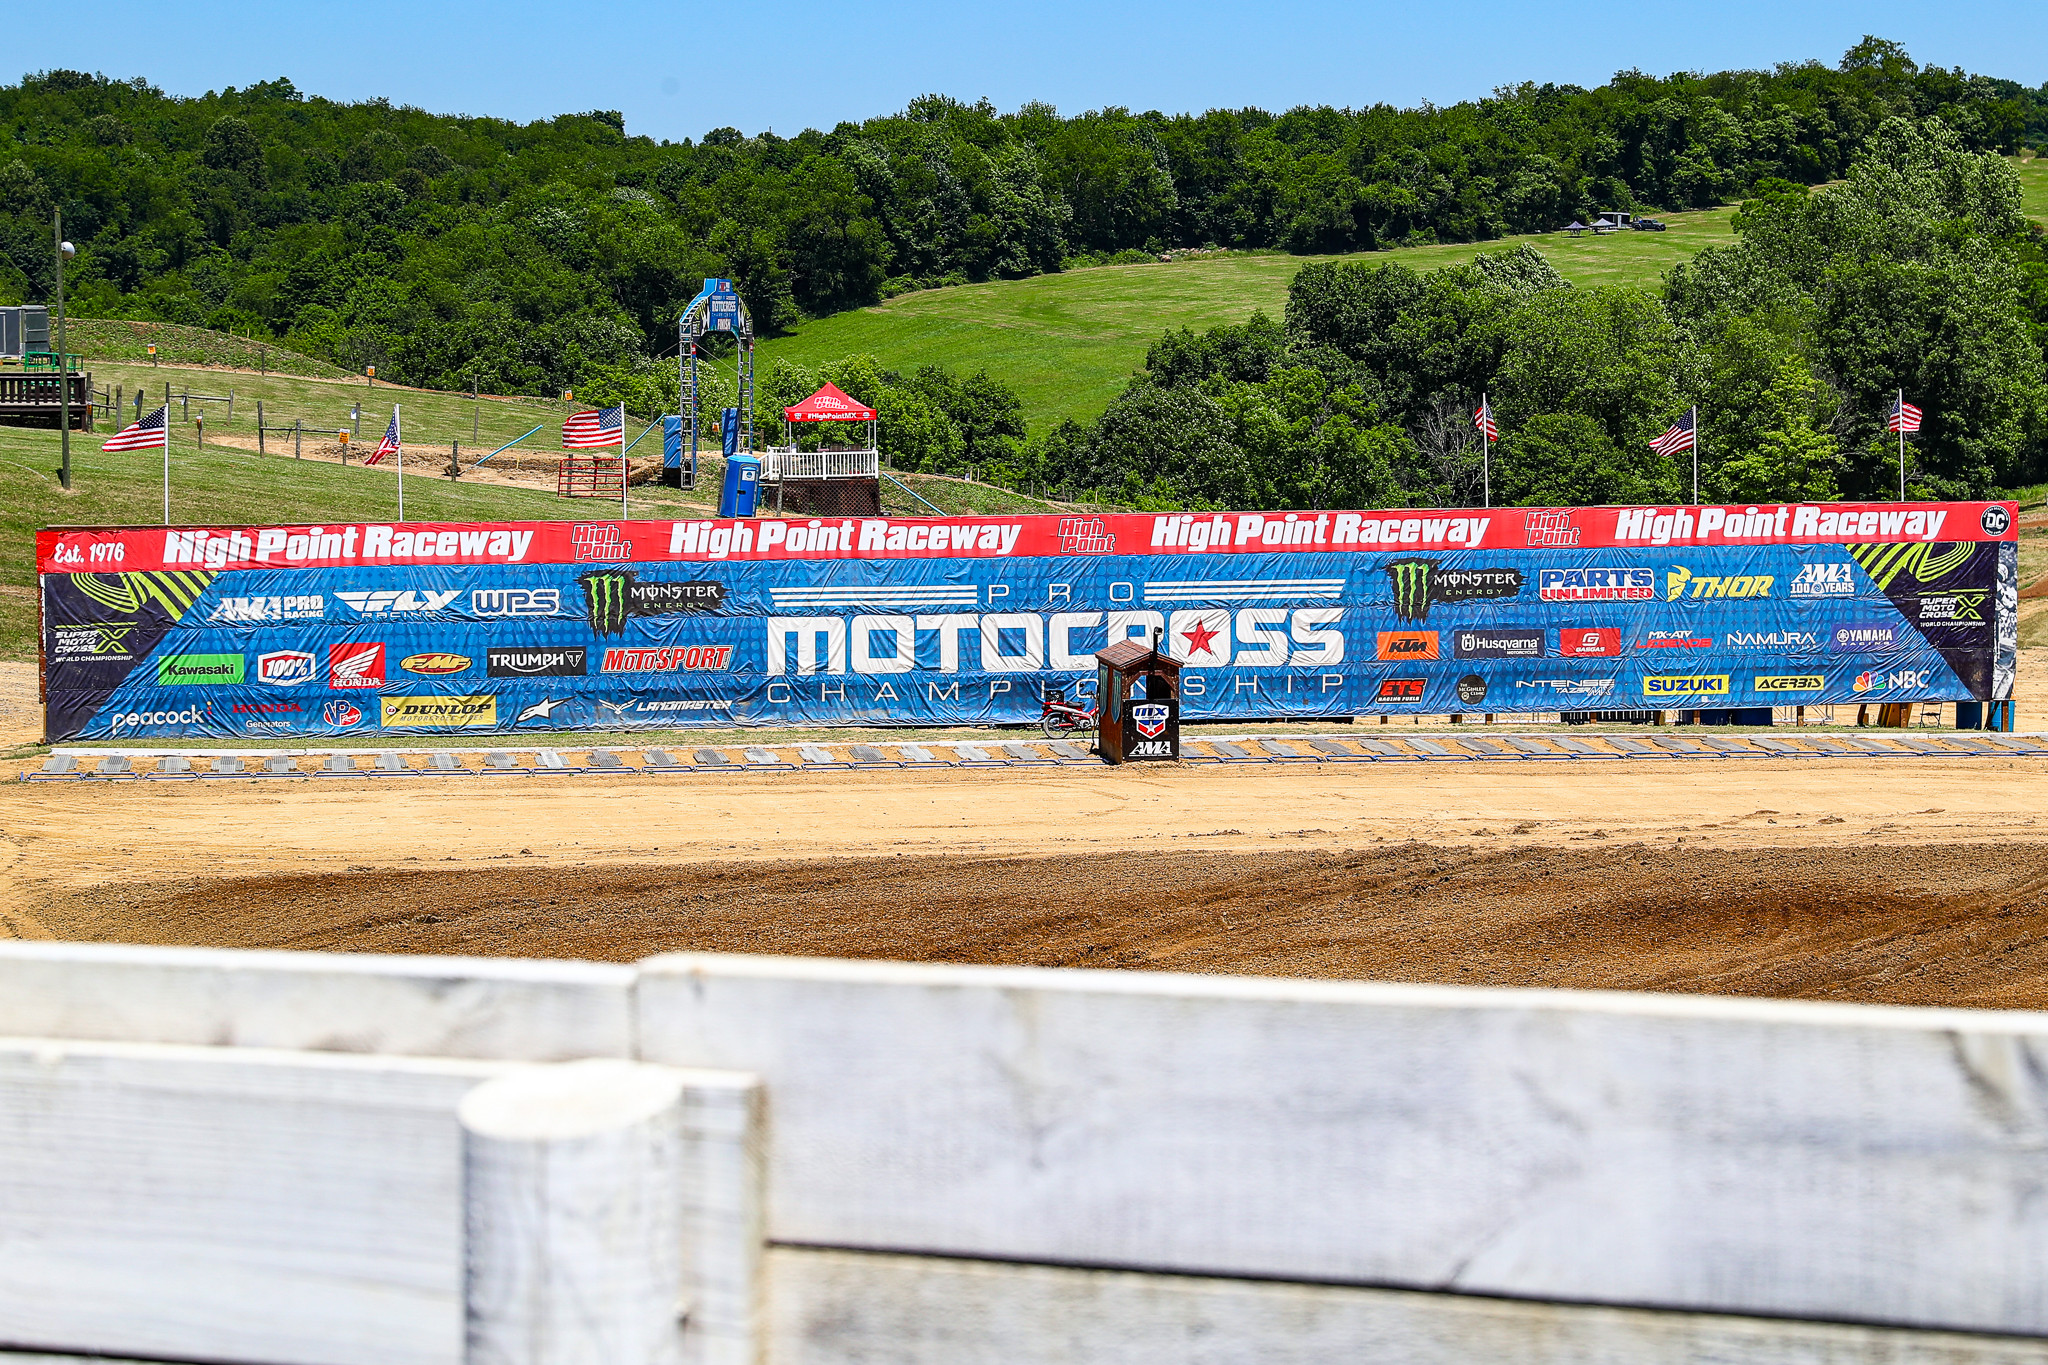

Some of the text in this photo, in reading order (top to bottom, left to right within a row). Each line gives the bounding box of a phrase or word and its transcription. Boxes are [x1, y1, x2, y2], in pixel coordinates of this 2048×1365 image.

[808, 412, 857, 420] #HighPointMX
[1057, 517, 1106, 537] High
[1524, 511, 1570, 530] High
[1614, 509, 1695, 545] High
[1697, 507, 1789, 538] Point
[1791, 506, 1948, 540] Raceway
[1986, 513, 2005, 529] DC
[571, 524, 620, 543] High
[669, 520, 1022, 558] High Point Raceway
[1150, 513, 1491, 551] High Point Raceway
[1527, 526, 1580, 546] Point
[163, 526, 534, 568] High Point Raceway
[574, 540, 632, 560] Point
[1060, 533, 1115, 553] Point
[54, 542, 125, 563] Est. 1976
[1434, 572, 1517, 587] MONSTER
[1541, 569, 1653, 588] PARTS
[1791, 563, 1854, 583] AMA
[630, 584, 720, 600] MONSTER
[988, 582, 1134, 603] PRO
[1541, 588, 1653, 600] UNLIMITED
[1691, 576, 1775, 598] THOR
[1790, 582, 1855, 593] 100 YEARS
[207, 596, 282, 620] AMA
[284, 595, 324, 610] PRO
[334, 590, 463, 612] FLY
[472, 589, 560, 616] WPS
[284, 610, 324, 619] RACING
[55, 630, 99, 638] SUPER
[58, 637, 96, 646] MOTO
[767, 608, 1345, 676] MOTOCROSS
[1727, 629, 1817, 646] NAMURA
[1849, 629, 1893, 642] YAMAHA
[55, 645, 96, 653] CROSS
[1388, 639, 1428, 653] KTM
[1476, 637, 1538, 649] Husqvarna
[1636, 638, 1713, 649] LEGENDS
[266, 659, 309, 677] 100%
[402, 656, 471, 669] FMF
[490, 653, 565, 669] TRIUMPH
[168, 664, 235, 676] Kawasaki
[332, 678, 382, 688] HONDA
[1516, 679, 1615, 688] INTENSE
[1648, 678, 1723, 691] SUZUKI
[1757, 678, 1822, 689] ACERBIS
[1887, 669, 1930, 689] NBC
[1380, 681, 1424, 696] ETS
[232, 702, 303, 713] HONDA
[325, 700, 350, 726] VP
[402, 704, 492, 715] DUNLOP
[636, 700, 733, 711] LANDMASTER
[112, 705, 204, 735] peacock
[246, 719, 291, 728] Generators
[400, 714, 456, 722] MOTORCYCLE
[1129, 741, 1172, 754] AMA
